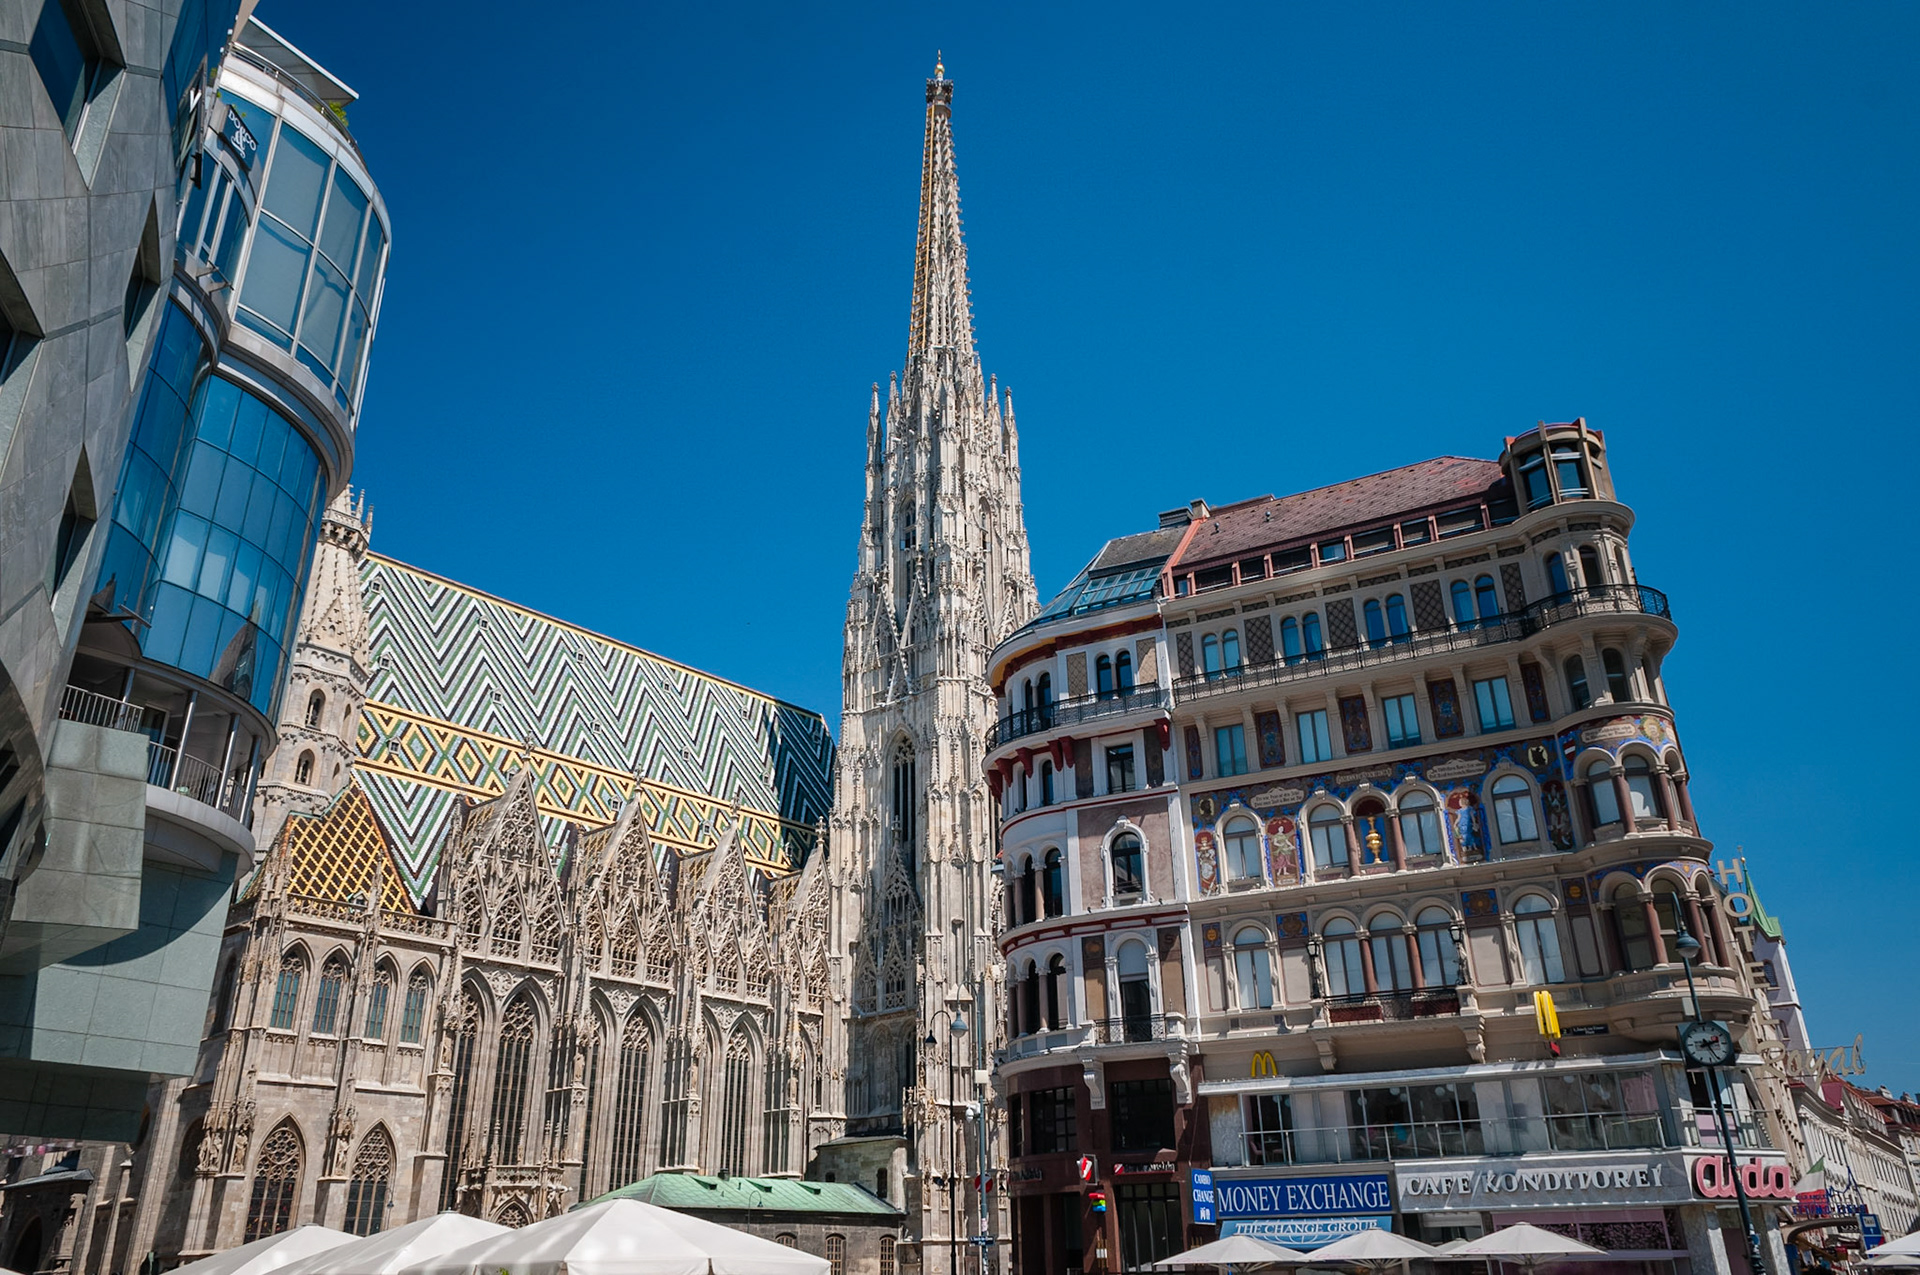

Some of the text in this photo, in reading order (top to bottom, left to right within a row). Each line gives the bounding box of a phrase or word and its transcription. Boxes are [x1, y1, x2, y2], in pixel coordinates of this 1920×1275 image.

[1717, 858, 1780, 1026] HOTEL
[1756, 1033, 1867, 1094] Royal
[1482, 1167, 1663, 1193] KONDITOREI
[1193, 1188, 1214, 1204] CHANGE
[1217, 1180, 1391, 1213] MONEY EXCHANGE
[1235, 1220, 1378, 1234] THE CHANGE GROUP
